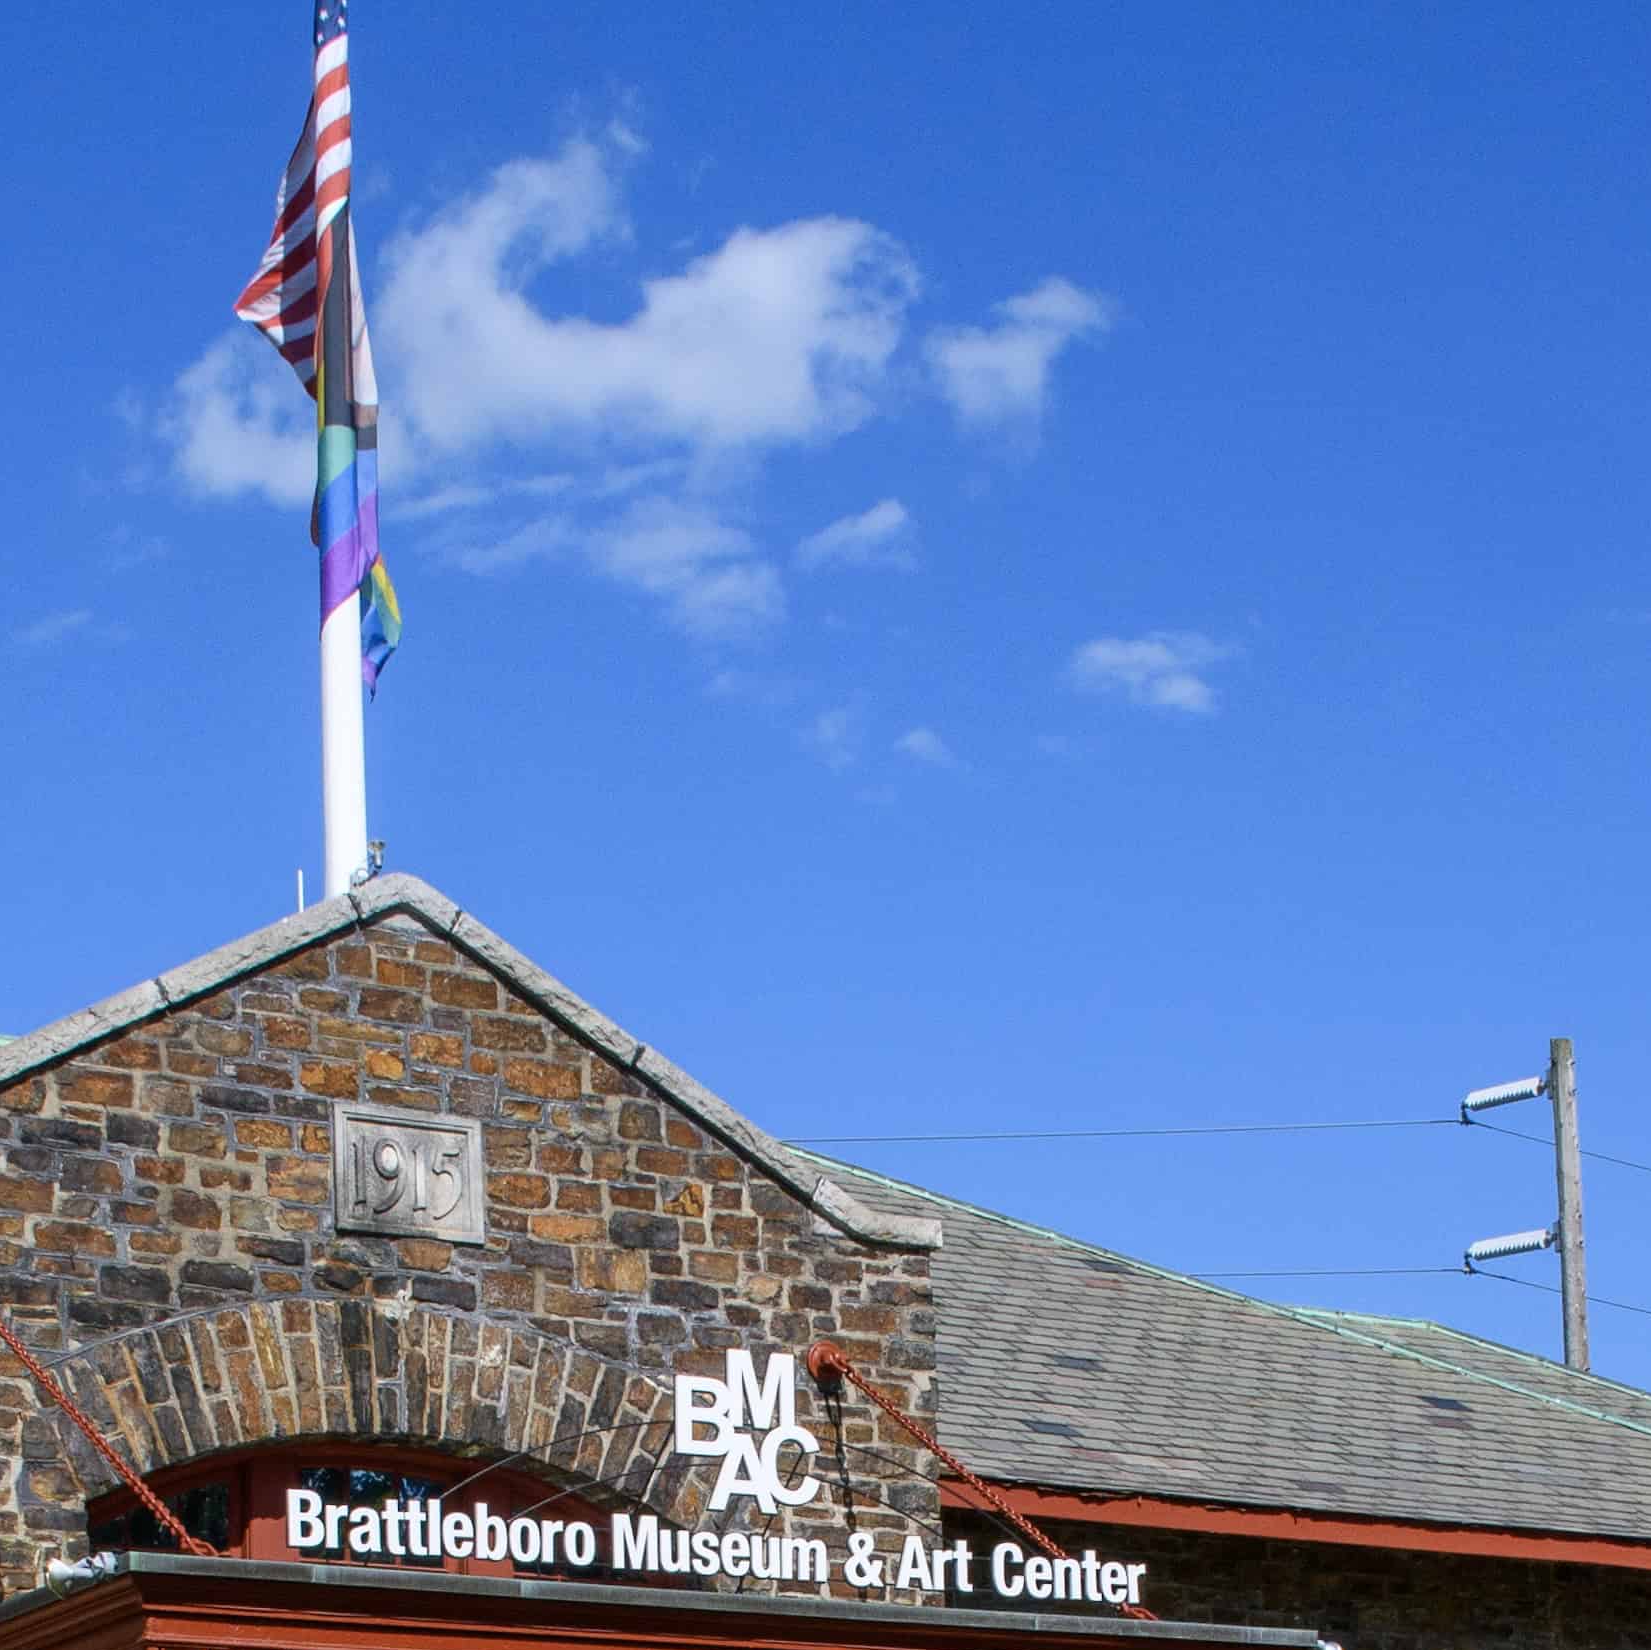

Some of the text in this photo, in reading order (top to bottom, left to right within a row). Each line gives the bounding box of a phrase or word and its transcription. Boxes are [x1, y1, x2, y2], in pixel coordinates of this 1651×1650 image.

[351, 1135, 462, 1220] 1915
[286, 1488, 1146, 1605] Brattleboro Museum & Art Center
